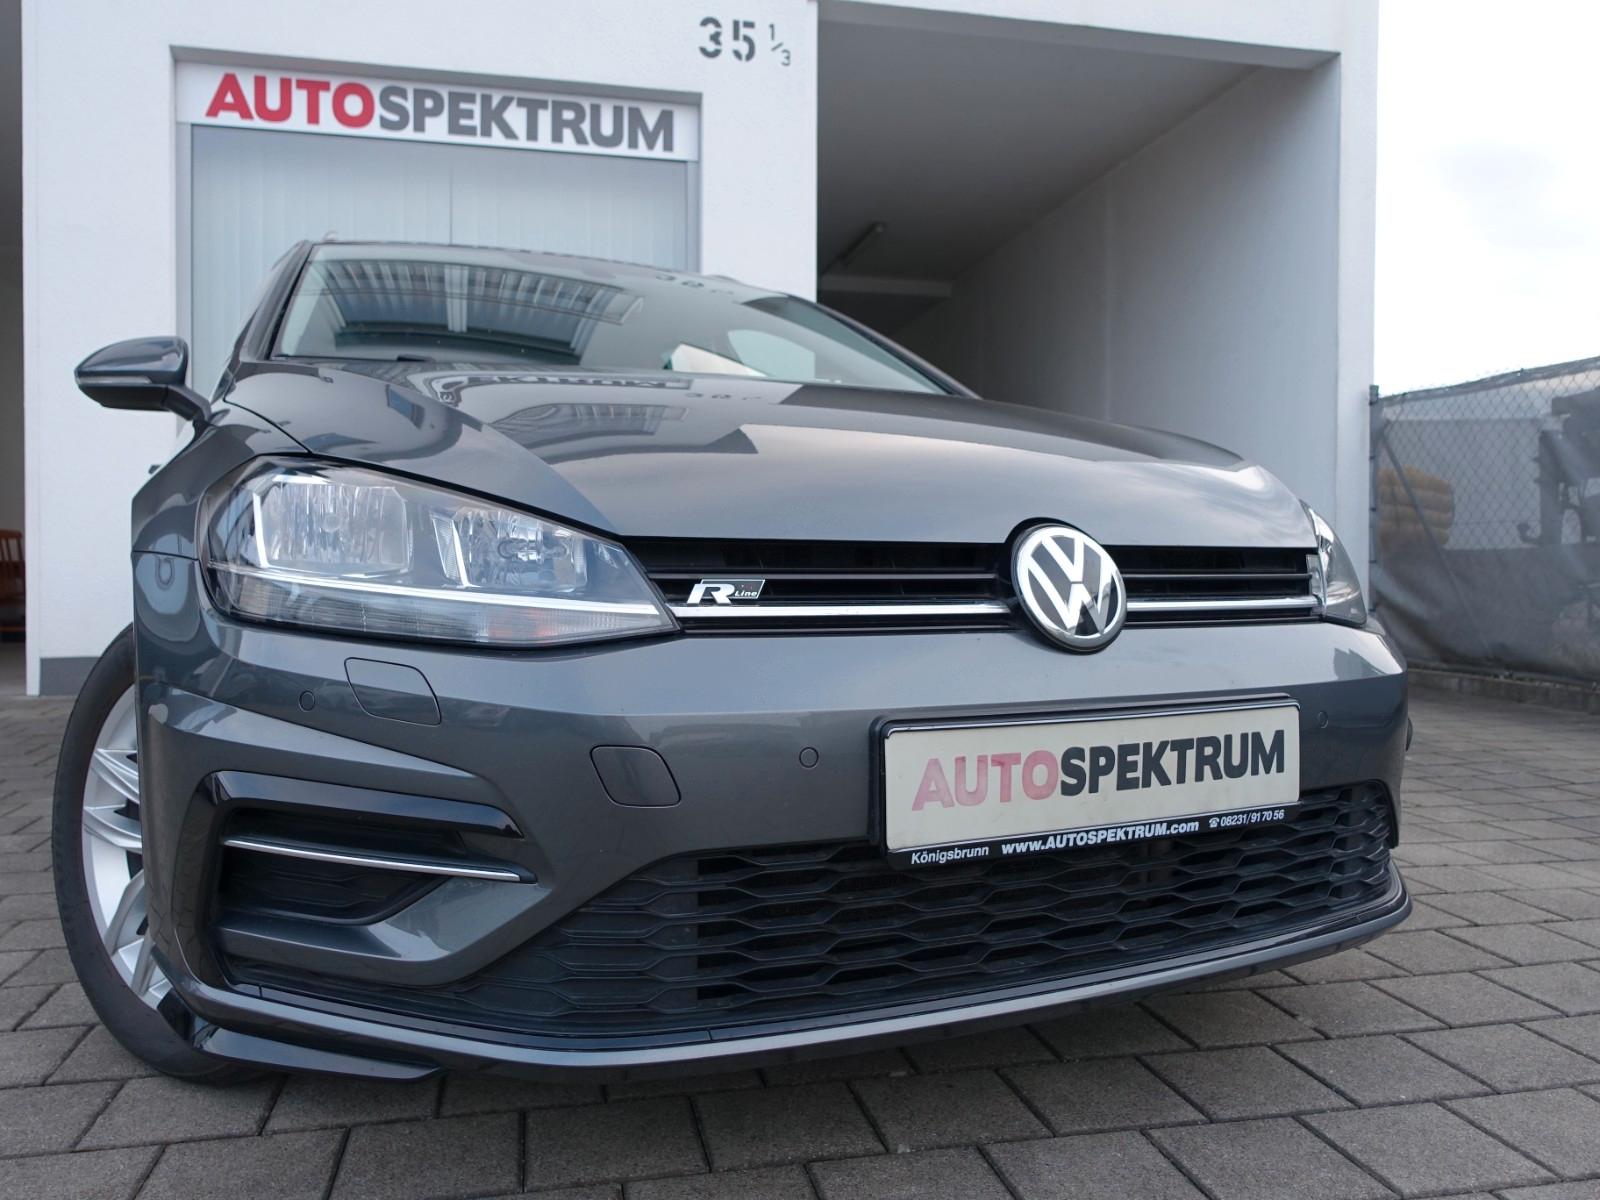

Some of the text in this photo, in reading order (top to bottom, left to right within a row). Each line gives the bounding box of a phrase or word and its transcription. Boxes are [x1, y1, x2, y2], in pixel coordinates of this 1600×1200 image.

[699, 16, 756, 62] 35
[205, 72, 675, 153] AUTOSPEKTRUM
[911, 729, 1285, 811] AUTOSPEKTRUM
[911, 845, 989, 865] Königsbrunn
[1001, 820, 1199, 854] www.AUTOSPEKTRUM.com
